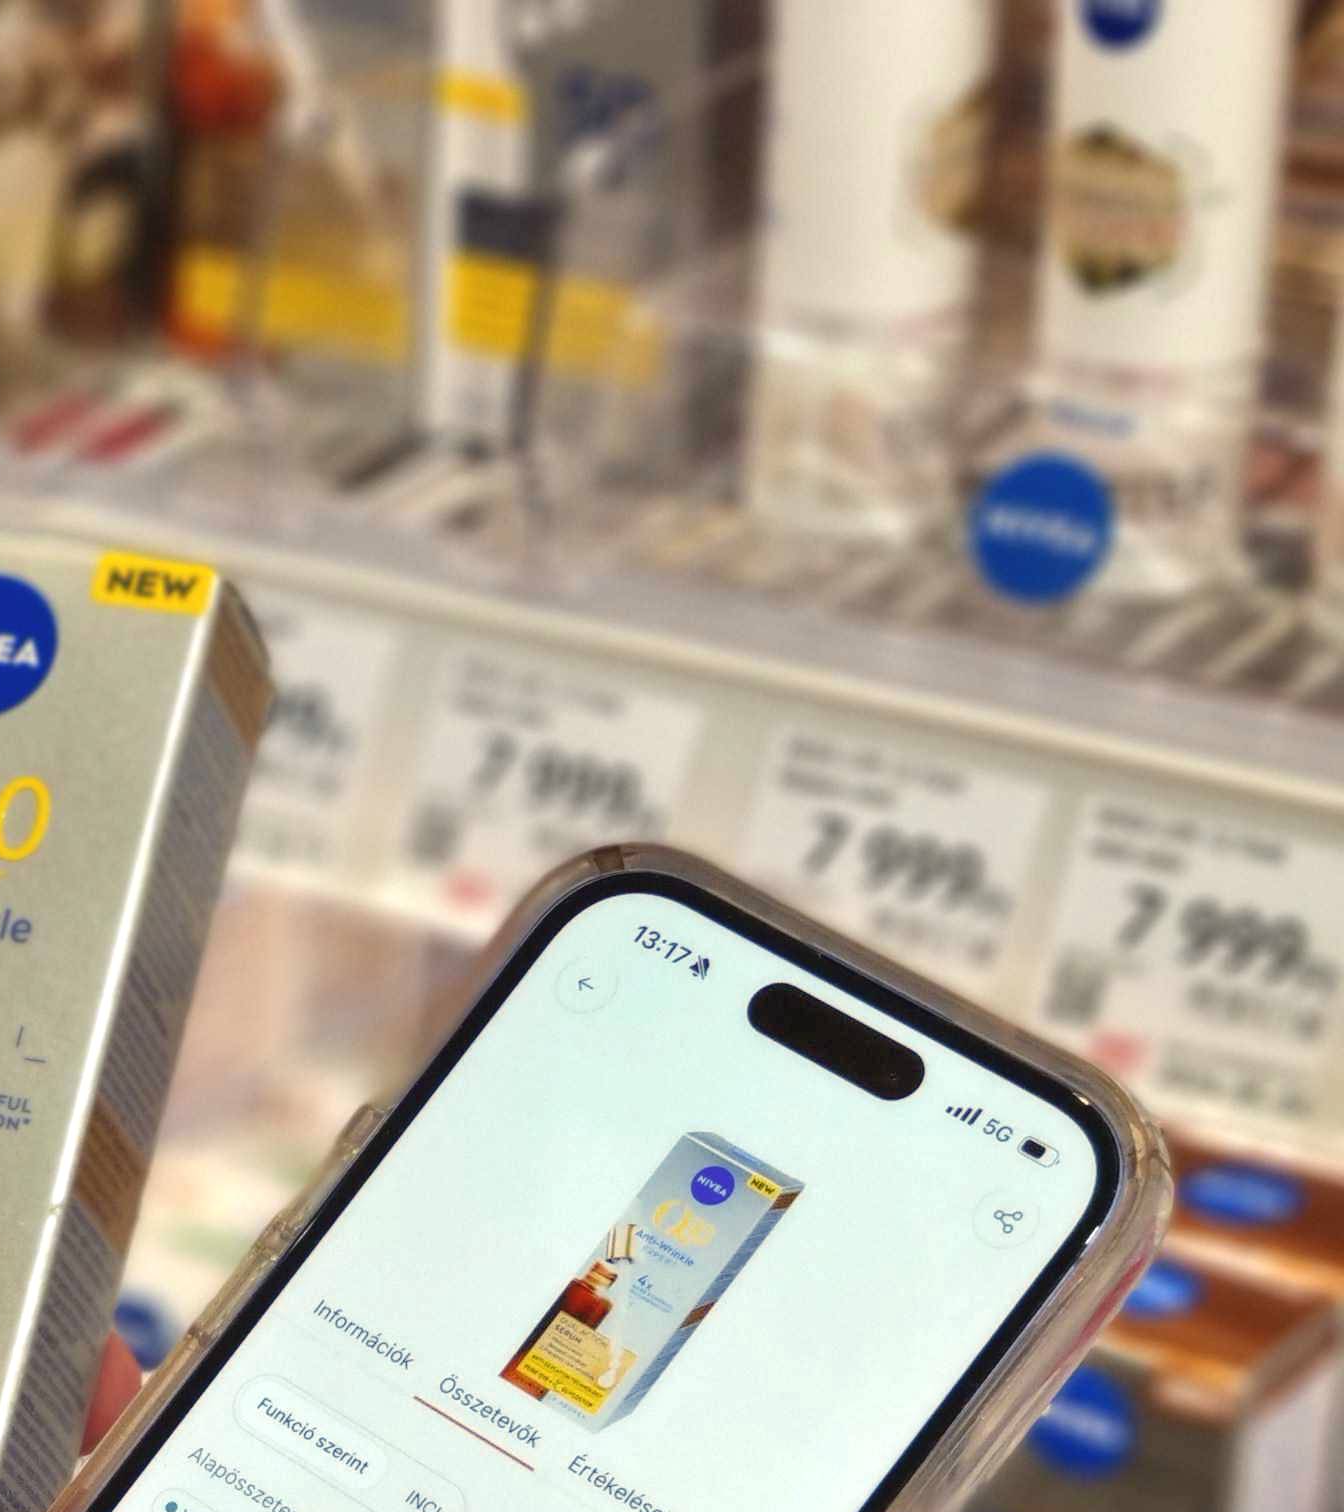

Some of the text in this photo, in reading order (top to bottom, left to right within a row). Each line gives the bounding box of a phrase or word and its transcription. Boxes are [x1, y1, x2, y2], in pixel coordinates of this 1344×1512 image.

[105, 567, 199, 600] NEW
[634, 926, 692, 963] 13:17
[983, 1118, 1014, 1142] 5G
[697, 1175, 727, 1198] NIVEA
[313, 1299, 414, 1370] Információk
[439, 1373, 542, 1449] Összetevők
[256, 1397, 369, 1475] Funkció szerint
